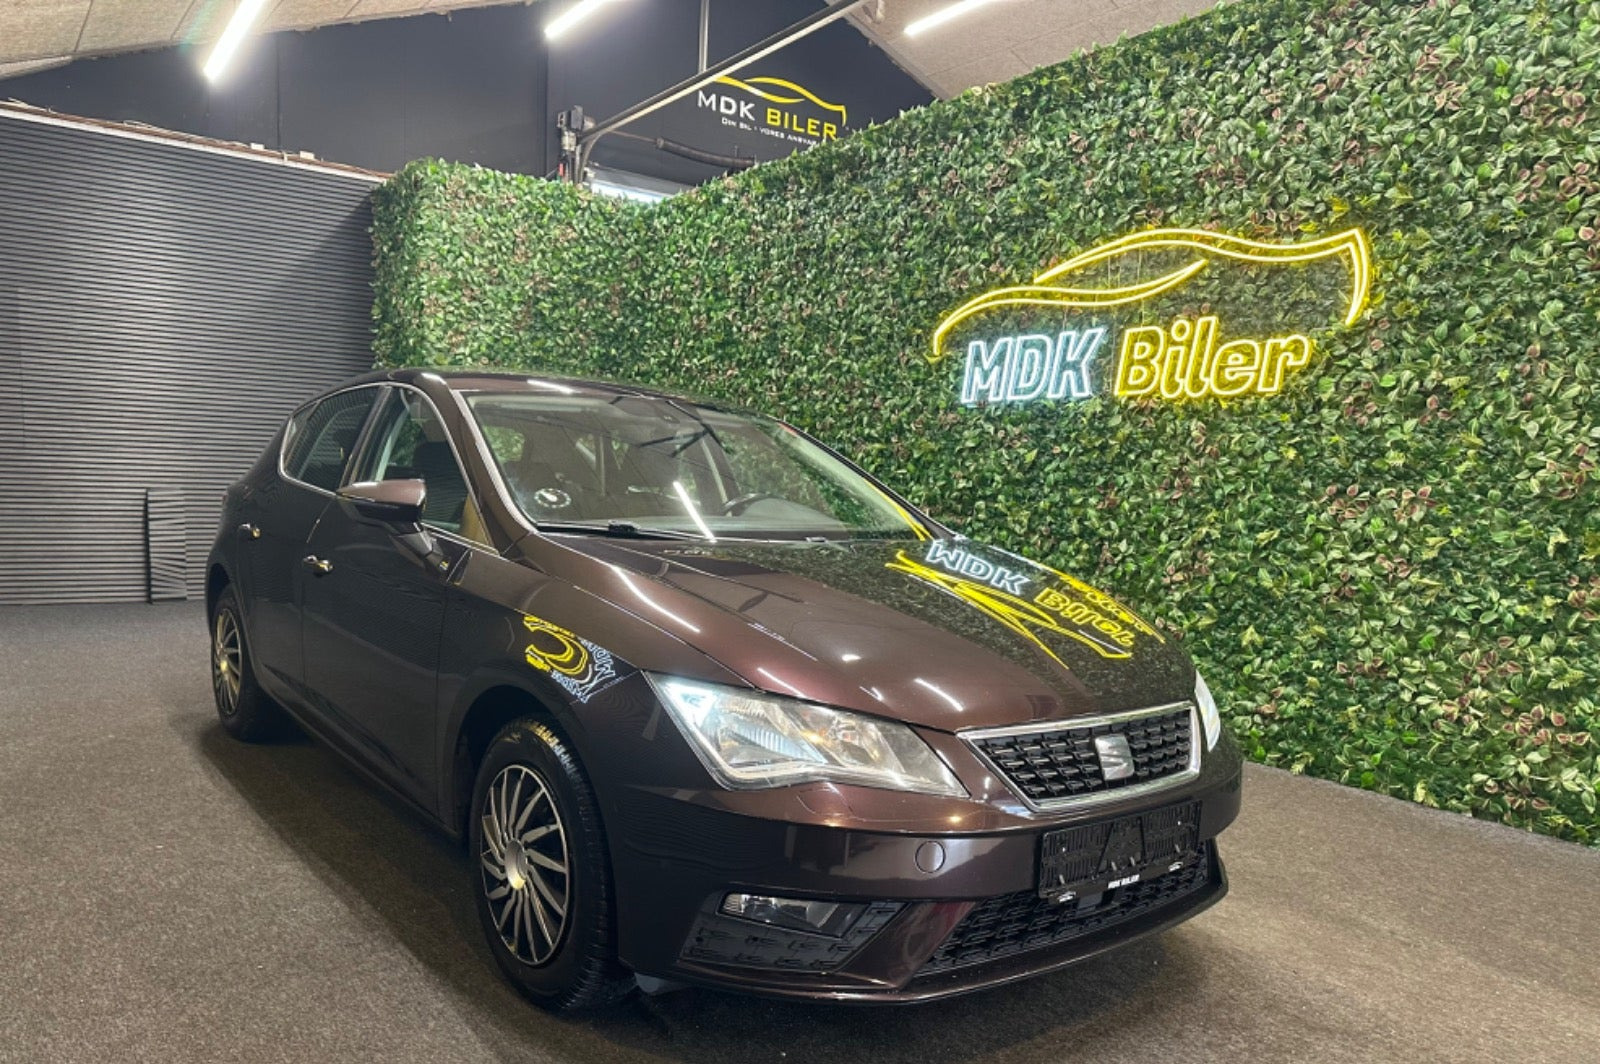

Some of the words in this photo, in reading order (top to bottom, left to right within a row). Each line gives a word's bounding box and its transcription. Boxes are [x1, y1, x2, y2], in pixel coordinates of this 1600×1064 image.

[697, 90, 755, 121] MDK
[766, 107, 837, 141] BILER
[960, 327, 1106, 402] MDK
[1113, 315, 1313, 399] Biler
